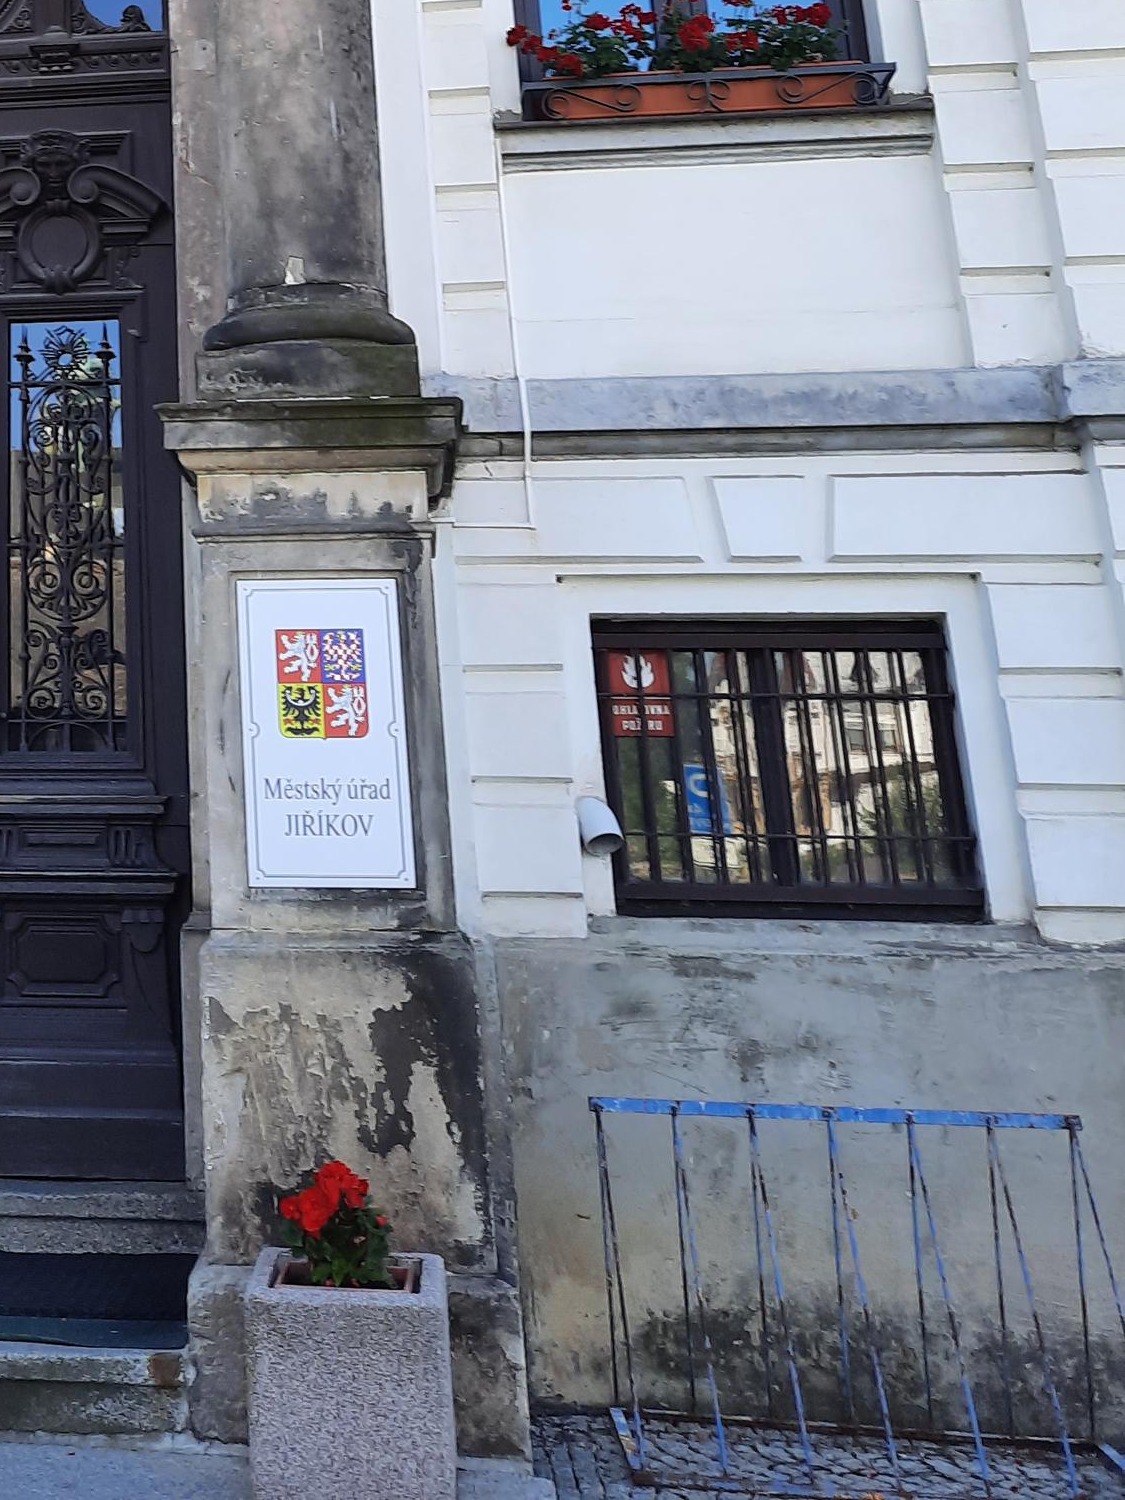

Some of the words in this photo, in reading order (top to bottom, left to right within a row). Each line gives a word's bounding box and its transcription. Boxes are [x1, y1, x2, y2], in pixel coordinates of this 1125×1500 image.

[264, 777, 342, 806] Městský
[347, 777, 392, 800] úřad
[283, 809, 375, 837] JIŘÍKOV
